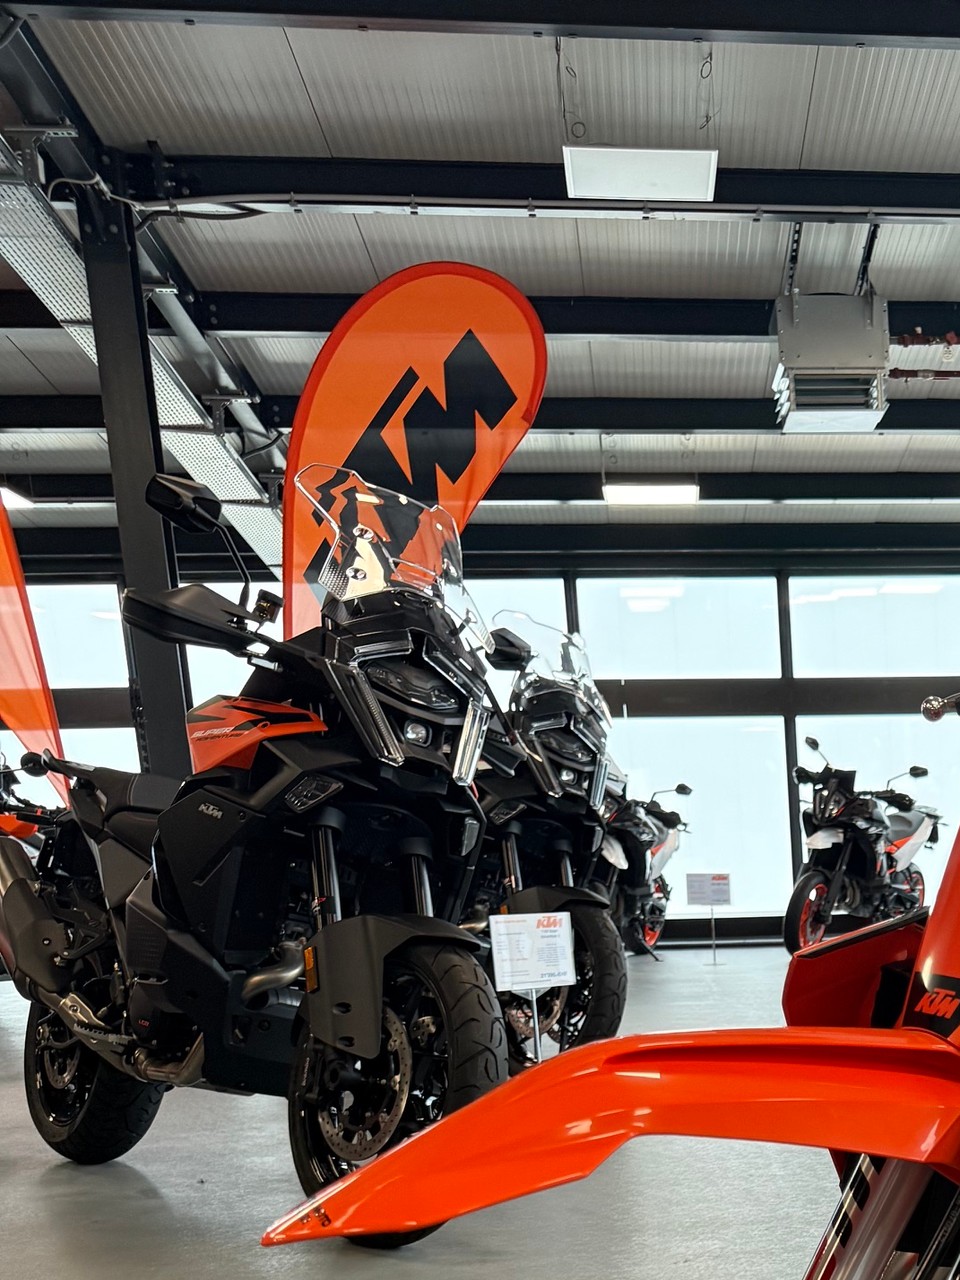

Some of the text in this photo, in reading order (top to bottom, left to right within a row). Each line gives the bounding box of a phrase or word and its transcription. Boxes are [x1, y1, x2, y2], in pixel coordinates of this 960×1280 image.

[190, 726, 236, 739] SUPER
[198, 802, 223, 819] KTM
[914, 988, 960, 1019] KTM
